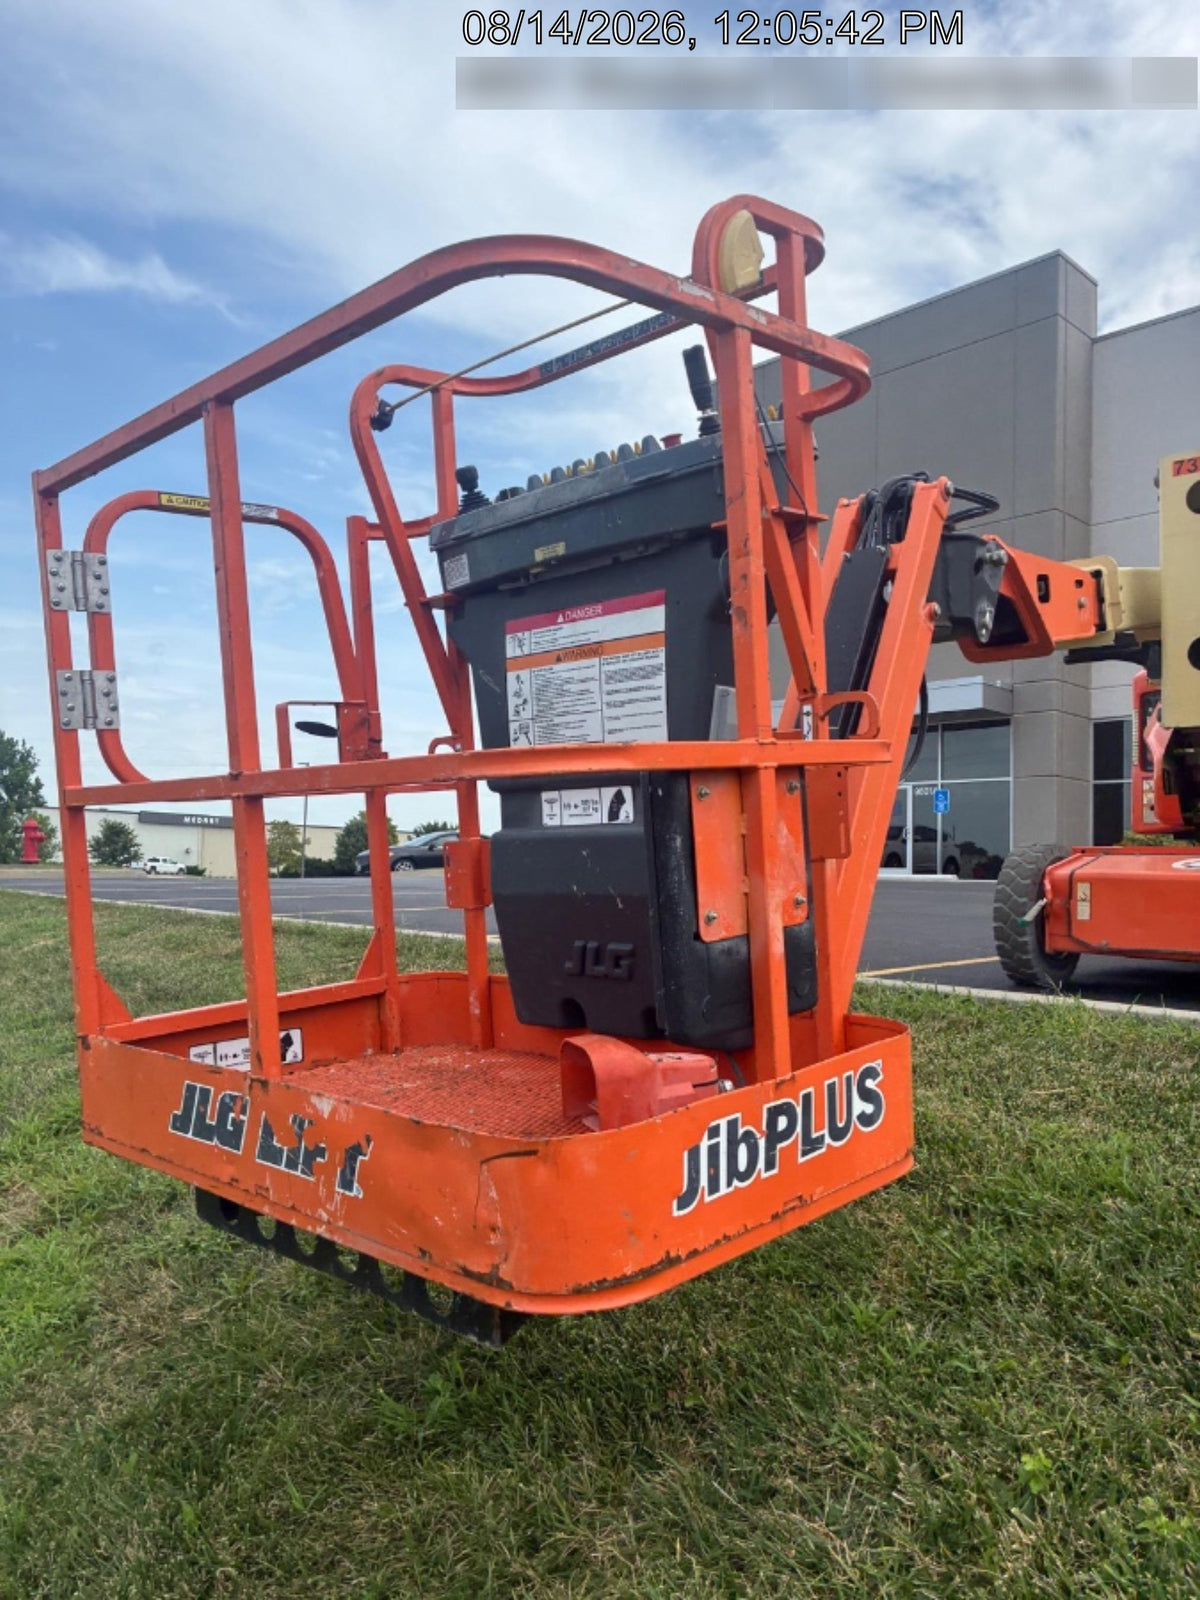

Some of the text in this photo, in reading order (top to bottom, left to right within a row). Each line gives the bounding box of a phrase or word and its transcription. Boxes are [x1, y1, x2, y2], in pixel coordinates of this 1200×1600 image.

[565, 604, 602, 621] DANGER
[560, 645, 603, 662] WARNING
[564, 939, 636, 980] JLG
[169, 1080, 250, 1155] JLG
[672, 1059, 884, 1217] JibPLUS
